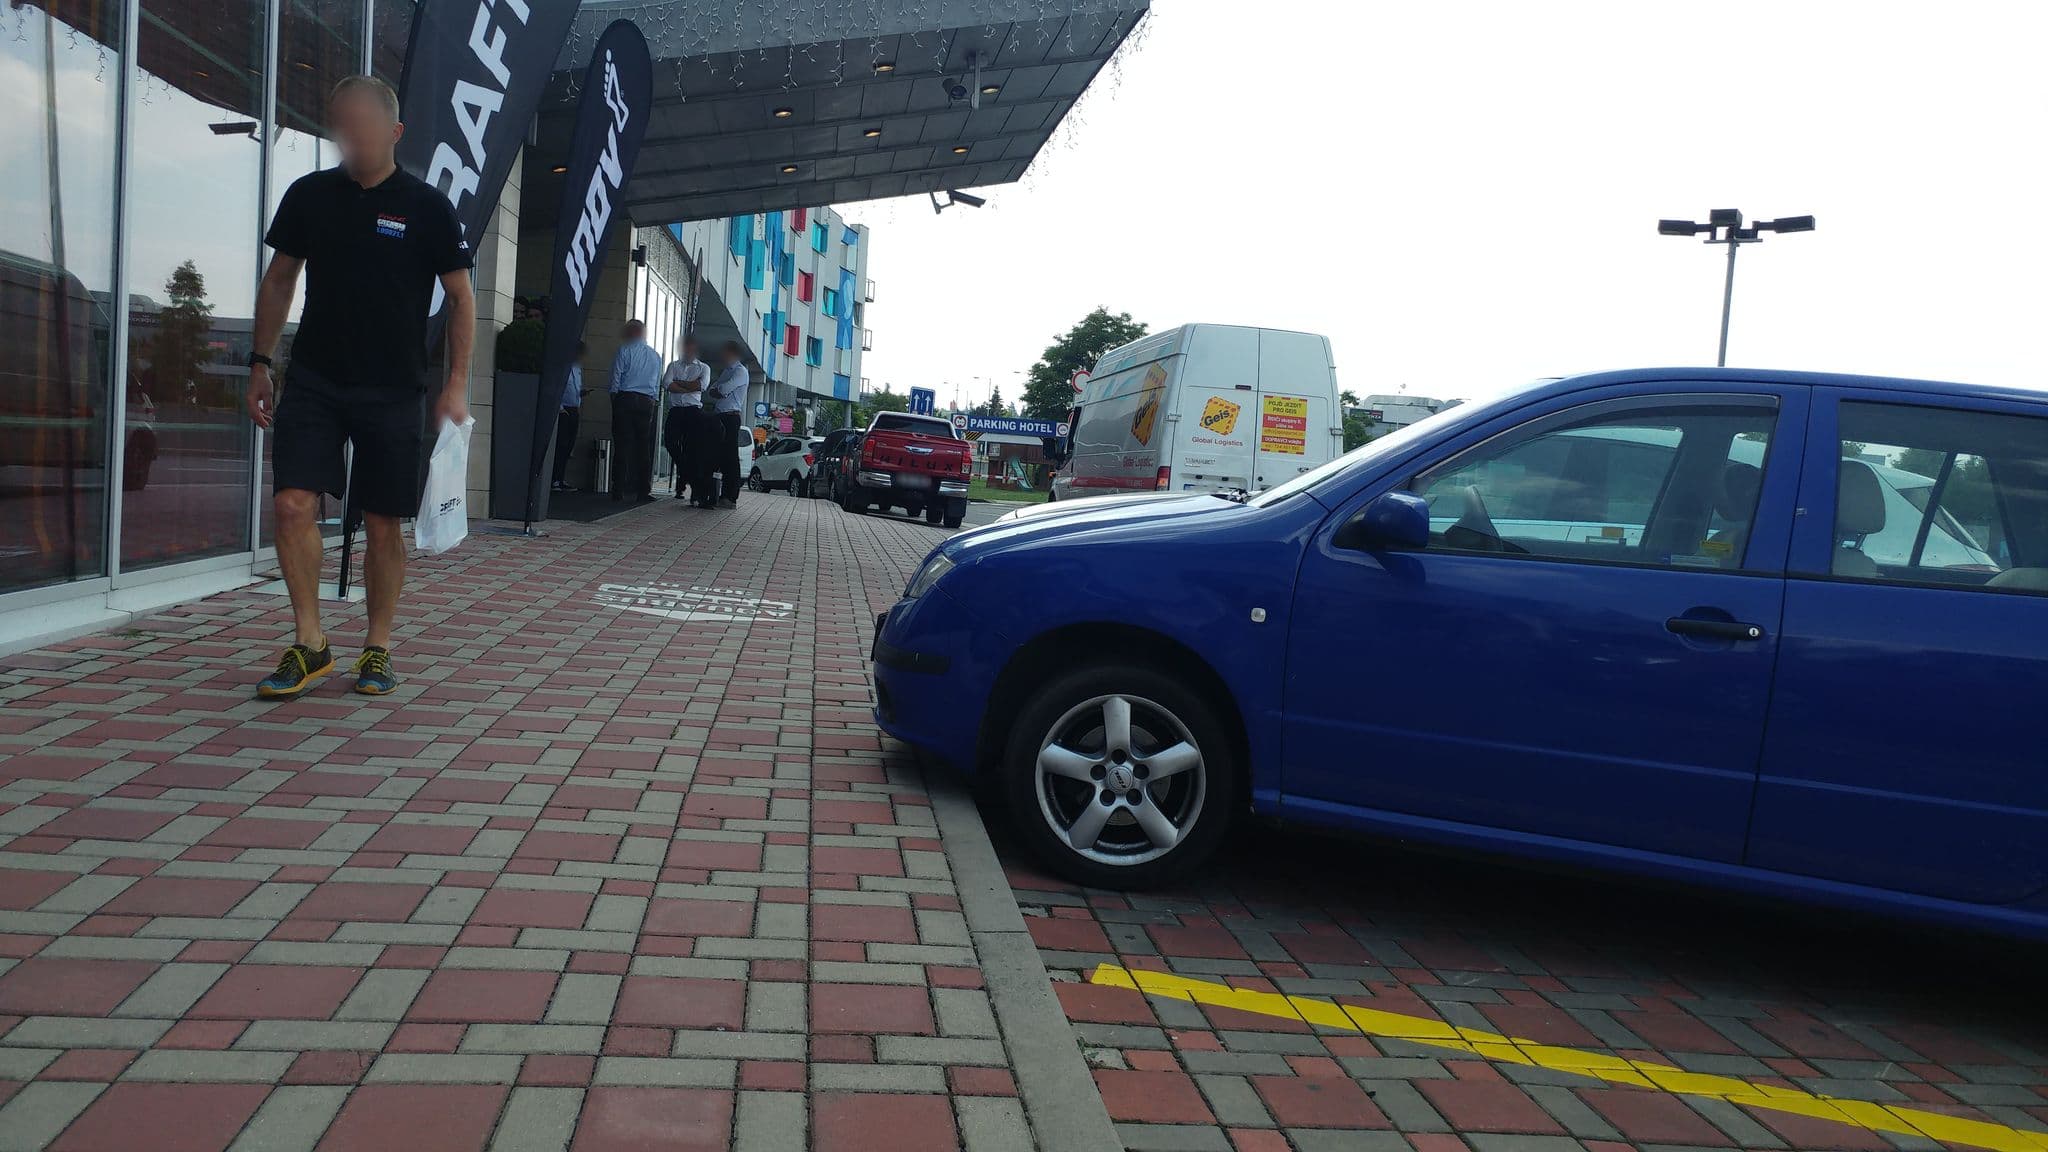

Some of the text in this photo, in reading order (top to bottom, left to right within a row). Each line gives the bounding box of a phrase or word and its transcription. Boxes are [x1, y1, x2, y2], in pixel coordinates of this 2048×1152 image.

[970, 418, 1053, 433] PARKING HOTEL
[1204, 409, 1230, 427] Geis
[1191, 436, 1243, 447] Global Logistics
